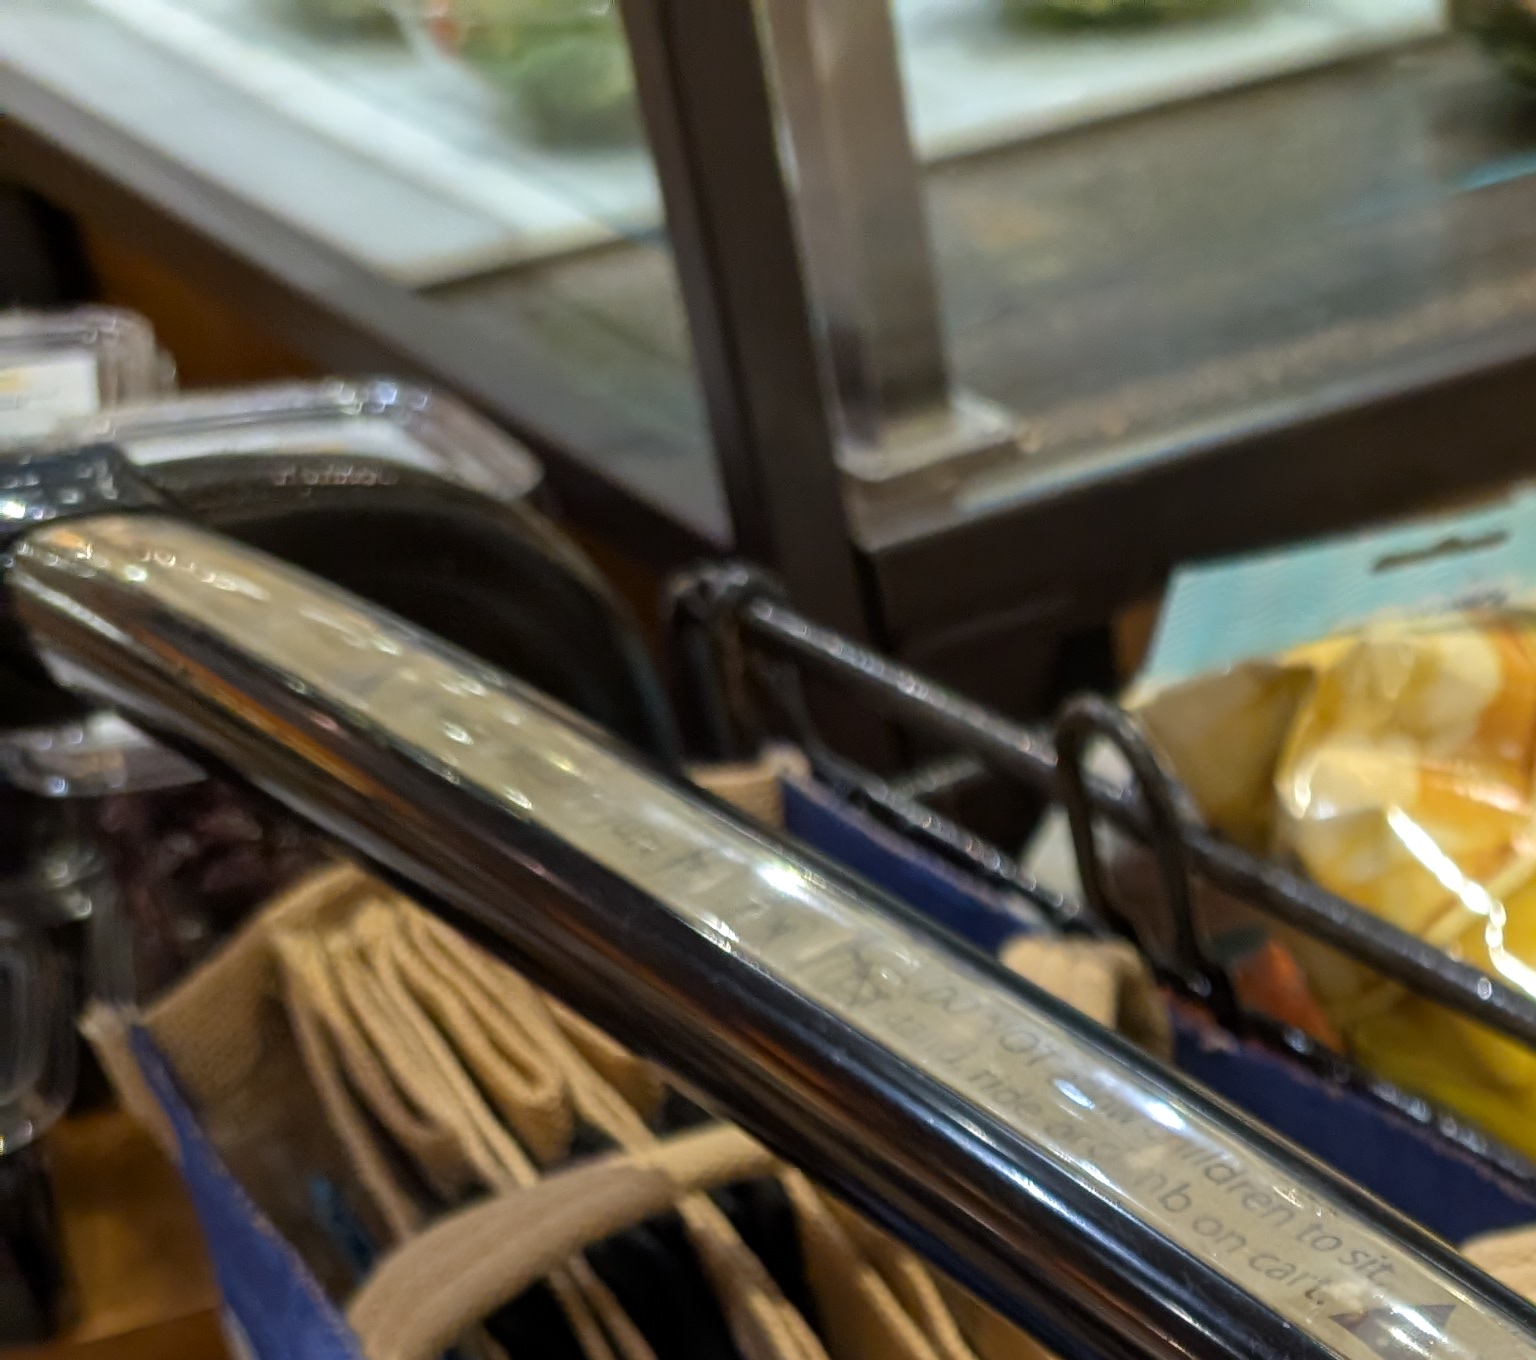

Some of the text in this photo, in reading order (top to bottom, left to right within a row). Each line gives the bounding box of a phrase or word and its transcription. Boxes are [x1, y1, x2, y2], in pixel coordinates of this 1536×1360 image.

[1192, 1216, 1246, 1252] on
[1249, 1253, 1332, 1305] cart.
[1296, 1222, 1343, 1252] to
